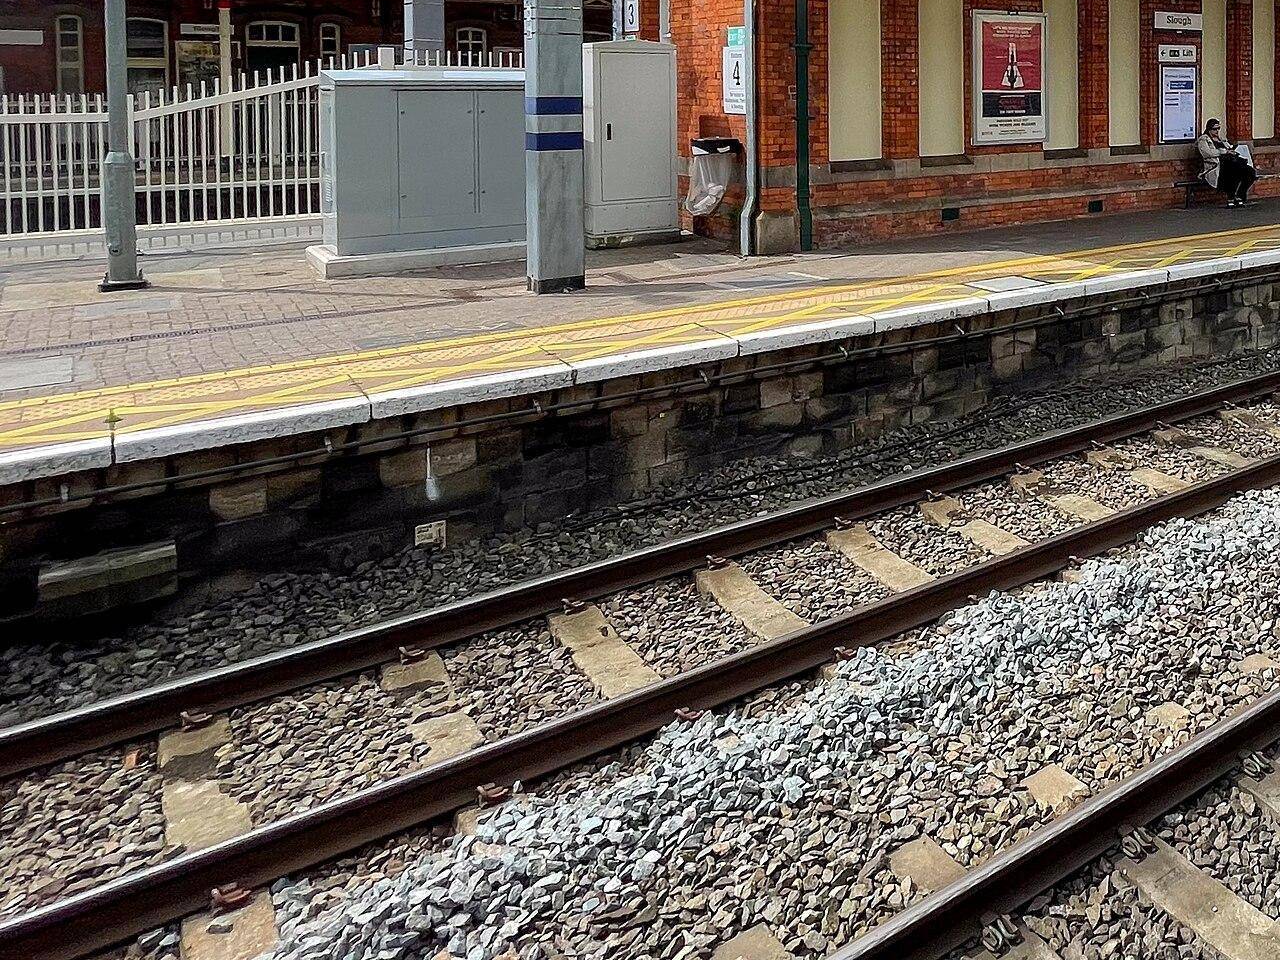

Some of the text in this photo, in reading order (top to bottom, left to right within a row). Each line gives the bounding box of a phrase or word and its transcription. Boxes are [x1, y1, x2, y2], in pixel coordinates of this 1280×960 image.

[628, 3, 634, 26] 3
[1166, 15, 1192, 26] Slough
[732, 60, 741, 86] 4
